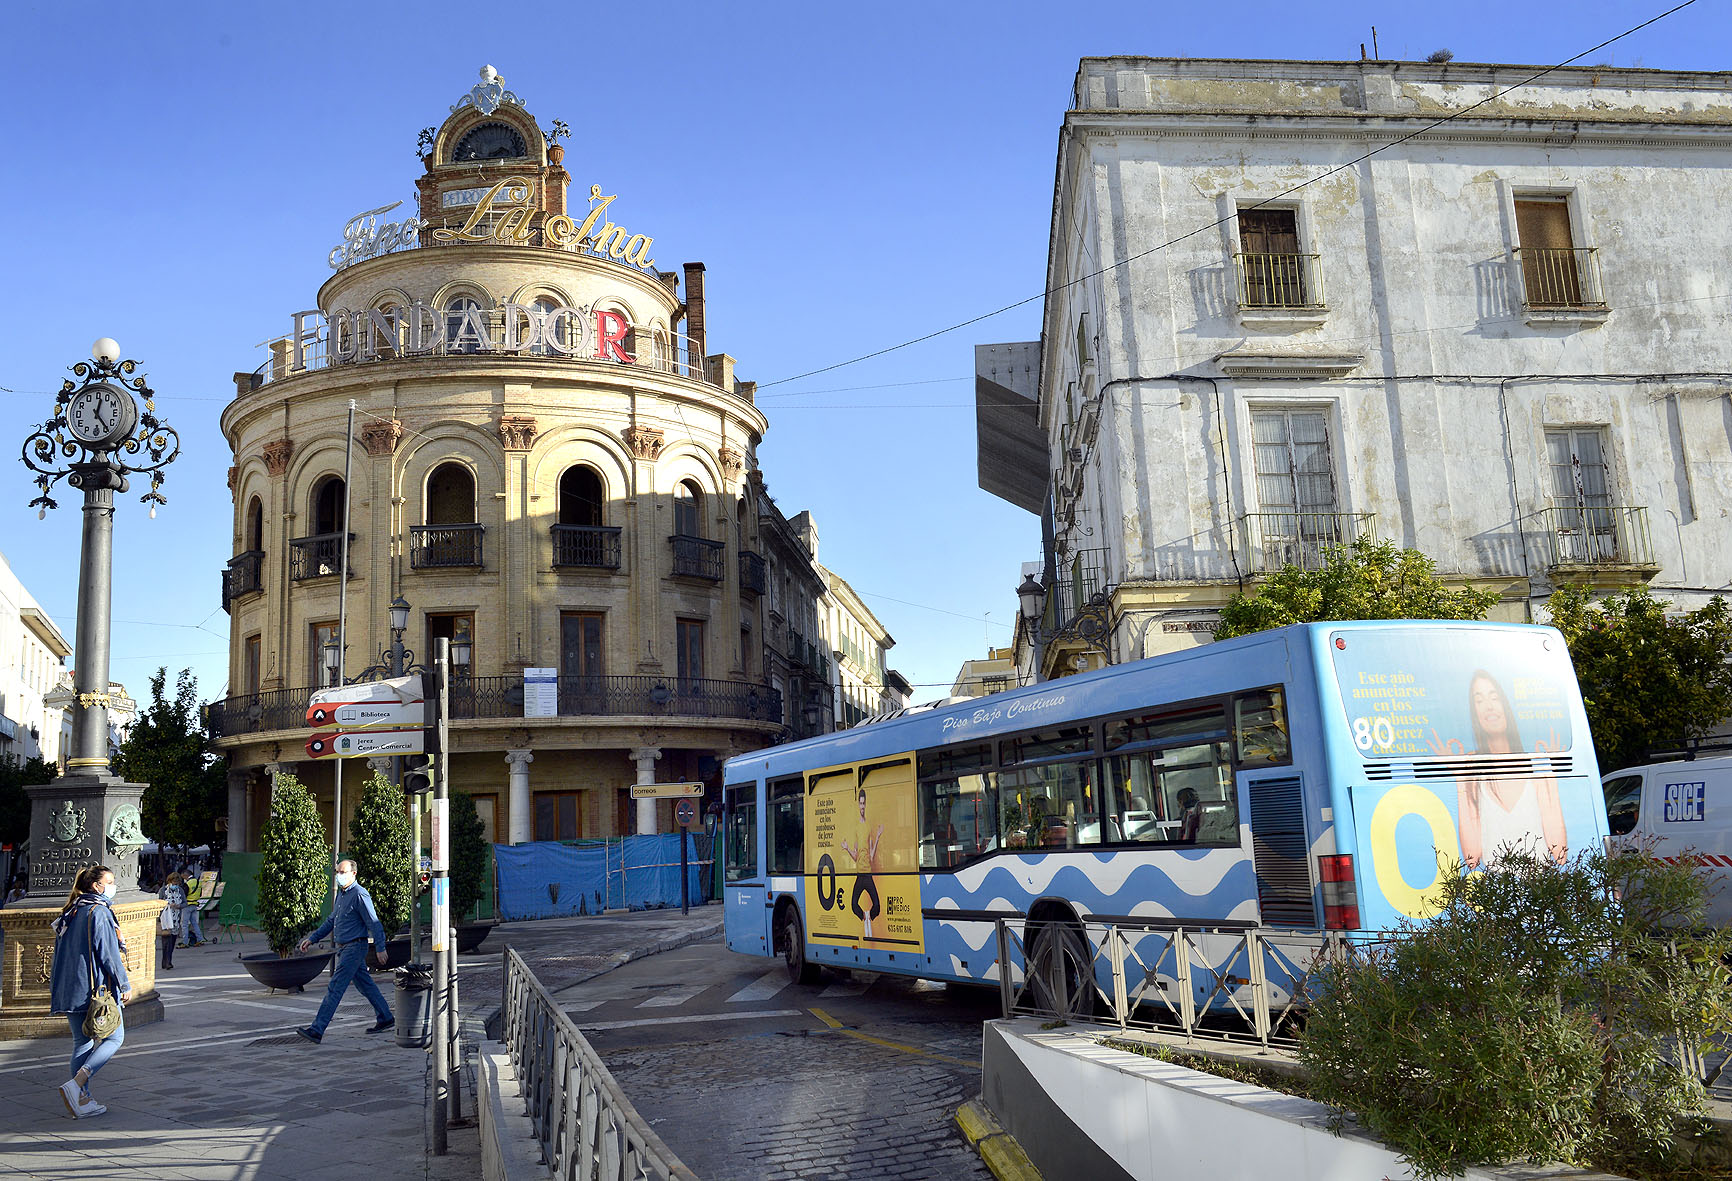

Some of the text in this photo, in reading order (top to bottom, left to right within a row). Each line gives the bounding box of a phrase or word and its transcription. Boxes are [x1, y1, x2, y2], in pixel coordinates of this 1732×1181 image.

[328, 175, 655, 270] Fino La Ina
[290, 301, 637, 373] FUNDADOR
[1358, 669, 1416, 685] Este año
[1352, 684, 1428, 699] anunciarse
[1373, 697, 1413, 712] en los
[942, 695, 1066, 732] Piso Bajo Continuo
[1353, 717, 1395, 751] 80
[1667, 783, 1703, 821] SICE
[41, 847, 93, 860] PEDRO
[893, 896, 904, 904] PRO
[893, 904, 911, 912] MEDIOS
